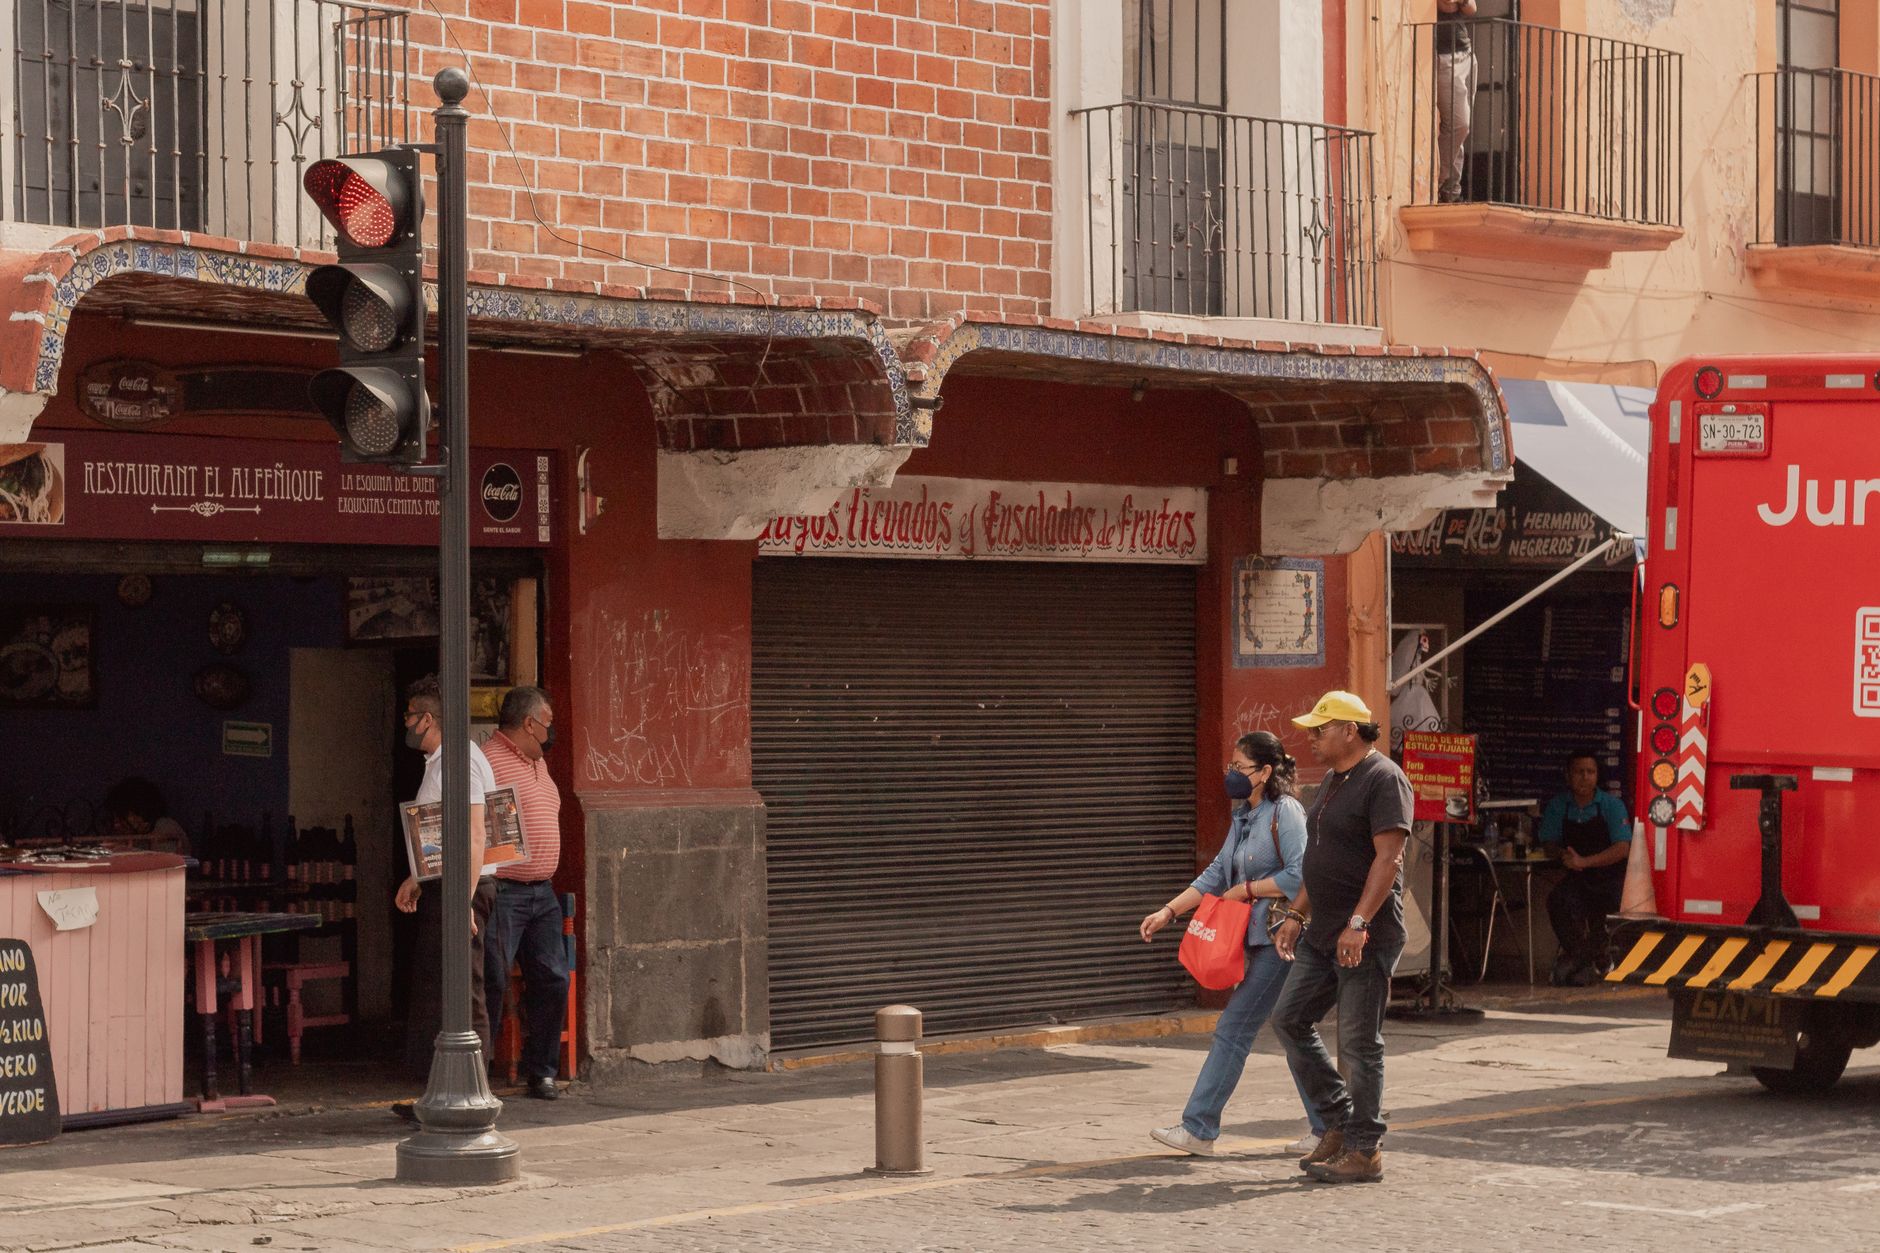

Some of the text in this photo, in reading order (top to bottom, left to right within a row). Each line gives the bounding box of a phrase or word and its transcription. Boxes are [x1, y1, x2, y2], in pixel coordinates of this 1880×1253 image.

[1703, 424, 1762, 439] SN-30-723
[84, 462, 324, 501] RESTAURANT EL ALFEÑIQUE
[341, 474, 436, 493] LA ESQUINA DEL BUEN
[338, 496, 385, 514] EXQUISITAS
[387, 498, 423, 515] CEMITAS
[1096, 508, 1116, 548] de
[1523, 511, 1597, 531] HERMANOS
[1509, 536, 1575, 557] NEGREROS
[1406, 742, 1474, 753] ESTILO TIJUANA
[1441, 736, 1453, 745] DE
[1454, 737, 1470, 745] RES
[1, 982, 29, 1009] POR
[13, 1018, 43, 1043] KILO
